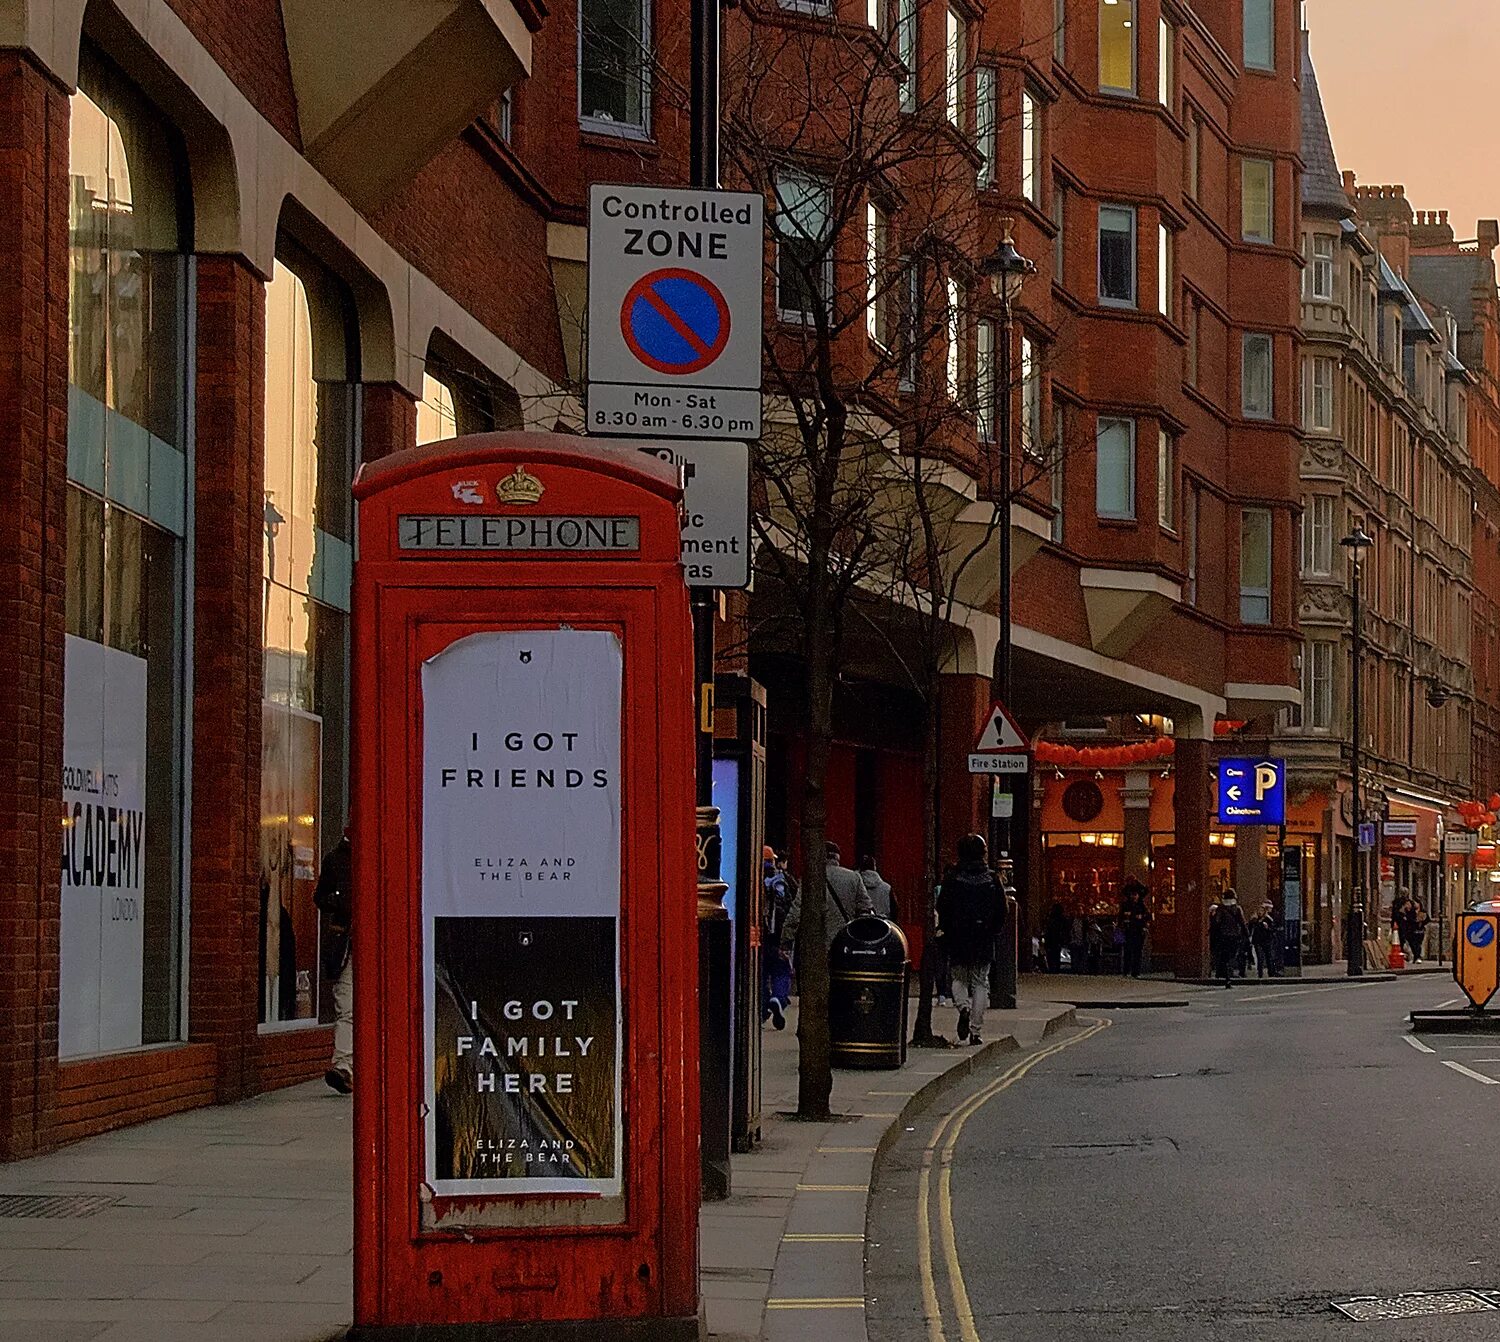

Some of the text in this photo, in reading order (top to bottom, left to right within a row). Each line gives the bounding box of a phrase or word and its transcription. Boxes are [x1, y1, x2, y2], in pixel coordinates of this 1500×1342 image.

[602, 196, 751, 225] Controlled
[624, 228, 728, 260] ZONE
[634, 392, 671, 407] Mon
[686, 394, 716, 409] Sat
[595, 411, 637, 426] 8.30
[642, 415, 667, 427] am
[682, 414, 723, 430] 6.30
[728, 418, 754, 432] pm
[406, 518, 630, 547] TELEPHONE
[471, 732, 578, 751] I GOT
[971, 758, 1024, 769] Fire Station
[441, 769, 608, 788] FRIENDS
[1255, 767, 1277, 801] P
[1226, 806, 1261, 815] Chinatown
[62, 801, 143, 888] ACADEMY
[474, 858, 576, 867] ELIZA AND
[480, 872, 572, 880] THE BEAR
[471, 1000, 579, 1020] I GOT
[457, 1036, 595, 1057] FAMILY
[477, 1072, 573, 1094] HERE
[476, 1139, 575, 1149] ELIZA AND
[480, 1153, 570, 1163] THE BEAR
